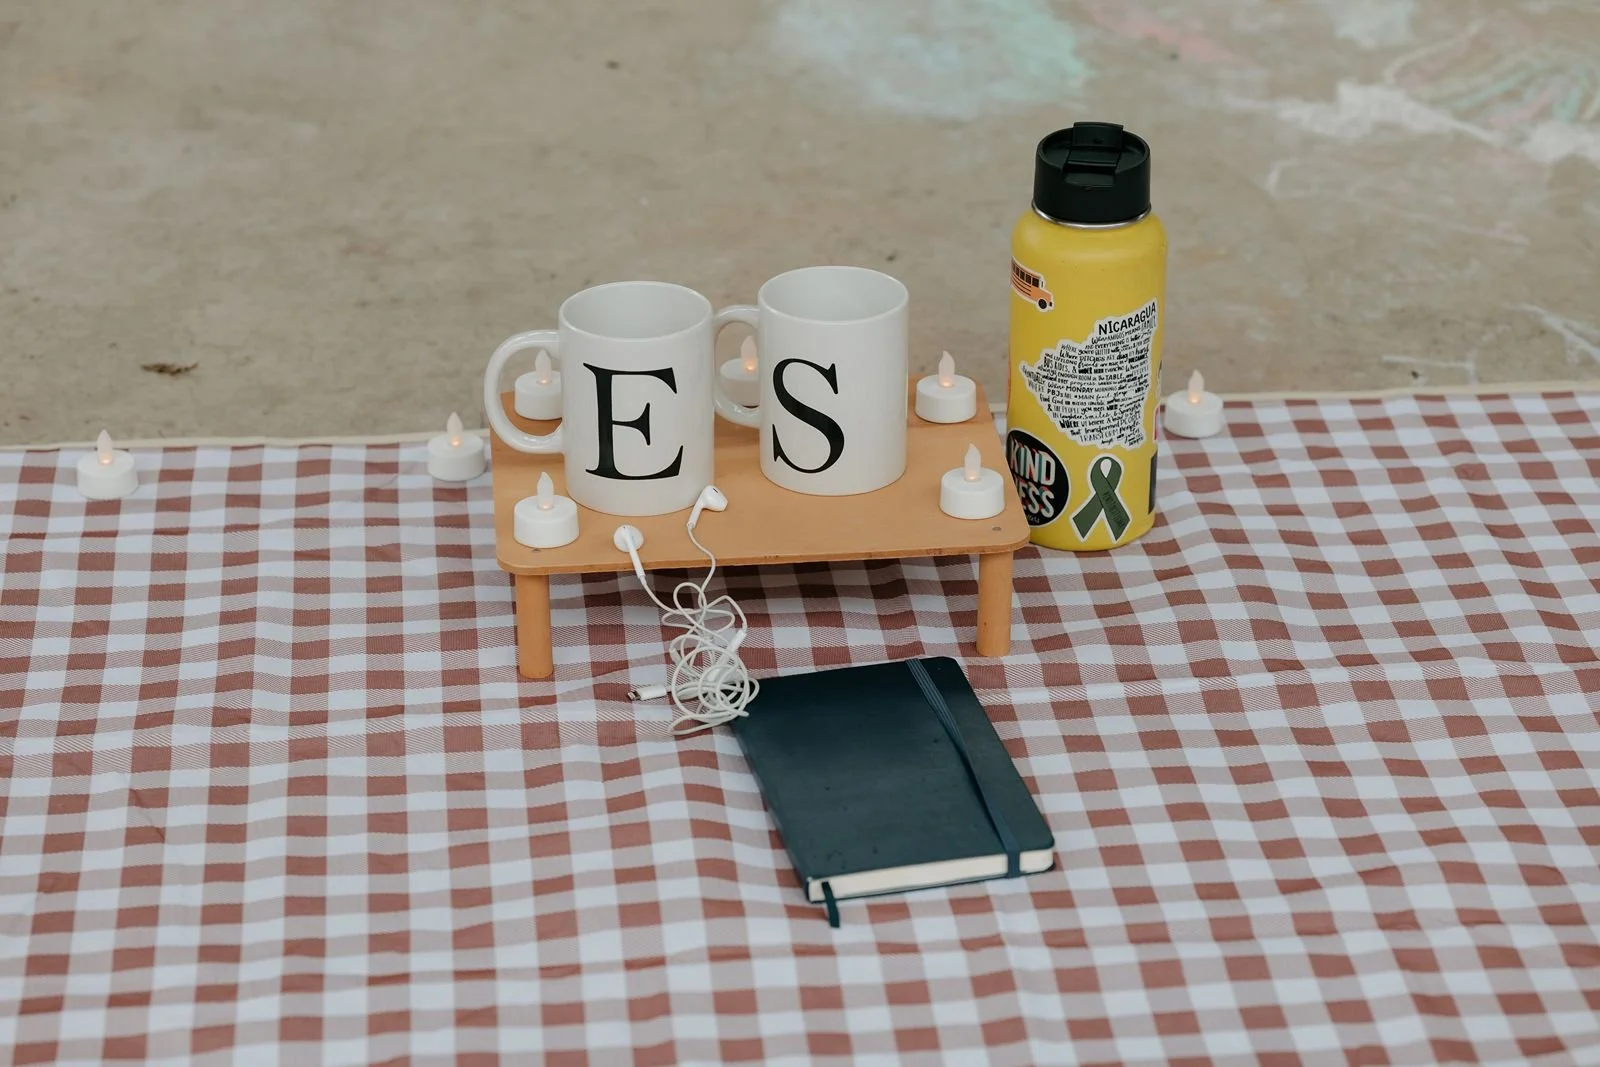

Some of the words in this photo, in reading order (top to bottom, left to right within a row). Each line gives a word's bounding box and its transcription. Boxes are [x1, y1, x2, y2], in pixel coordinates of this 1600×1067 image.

[1098, 301, 1157, 336] NICARAGUA
[1095, 339, 1125, 349] EVERYTHING
[1057, 372, 1078, 380] ENOUGH
[1066, 385, 1094, 393] MONDAY
[582, 362, 685, 481] E
[771, 357, 845, 474] S
